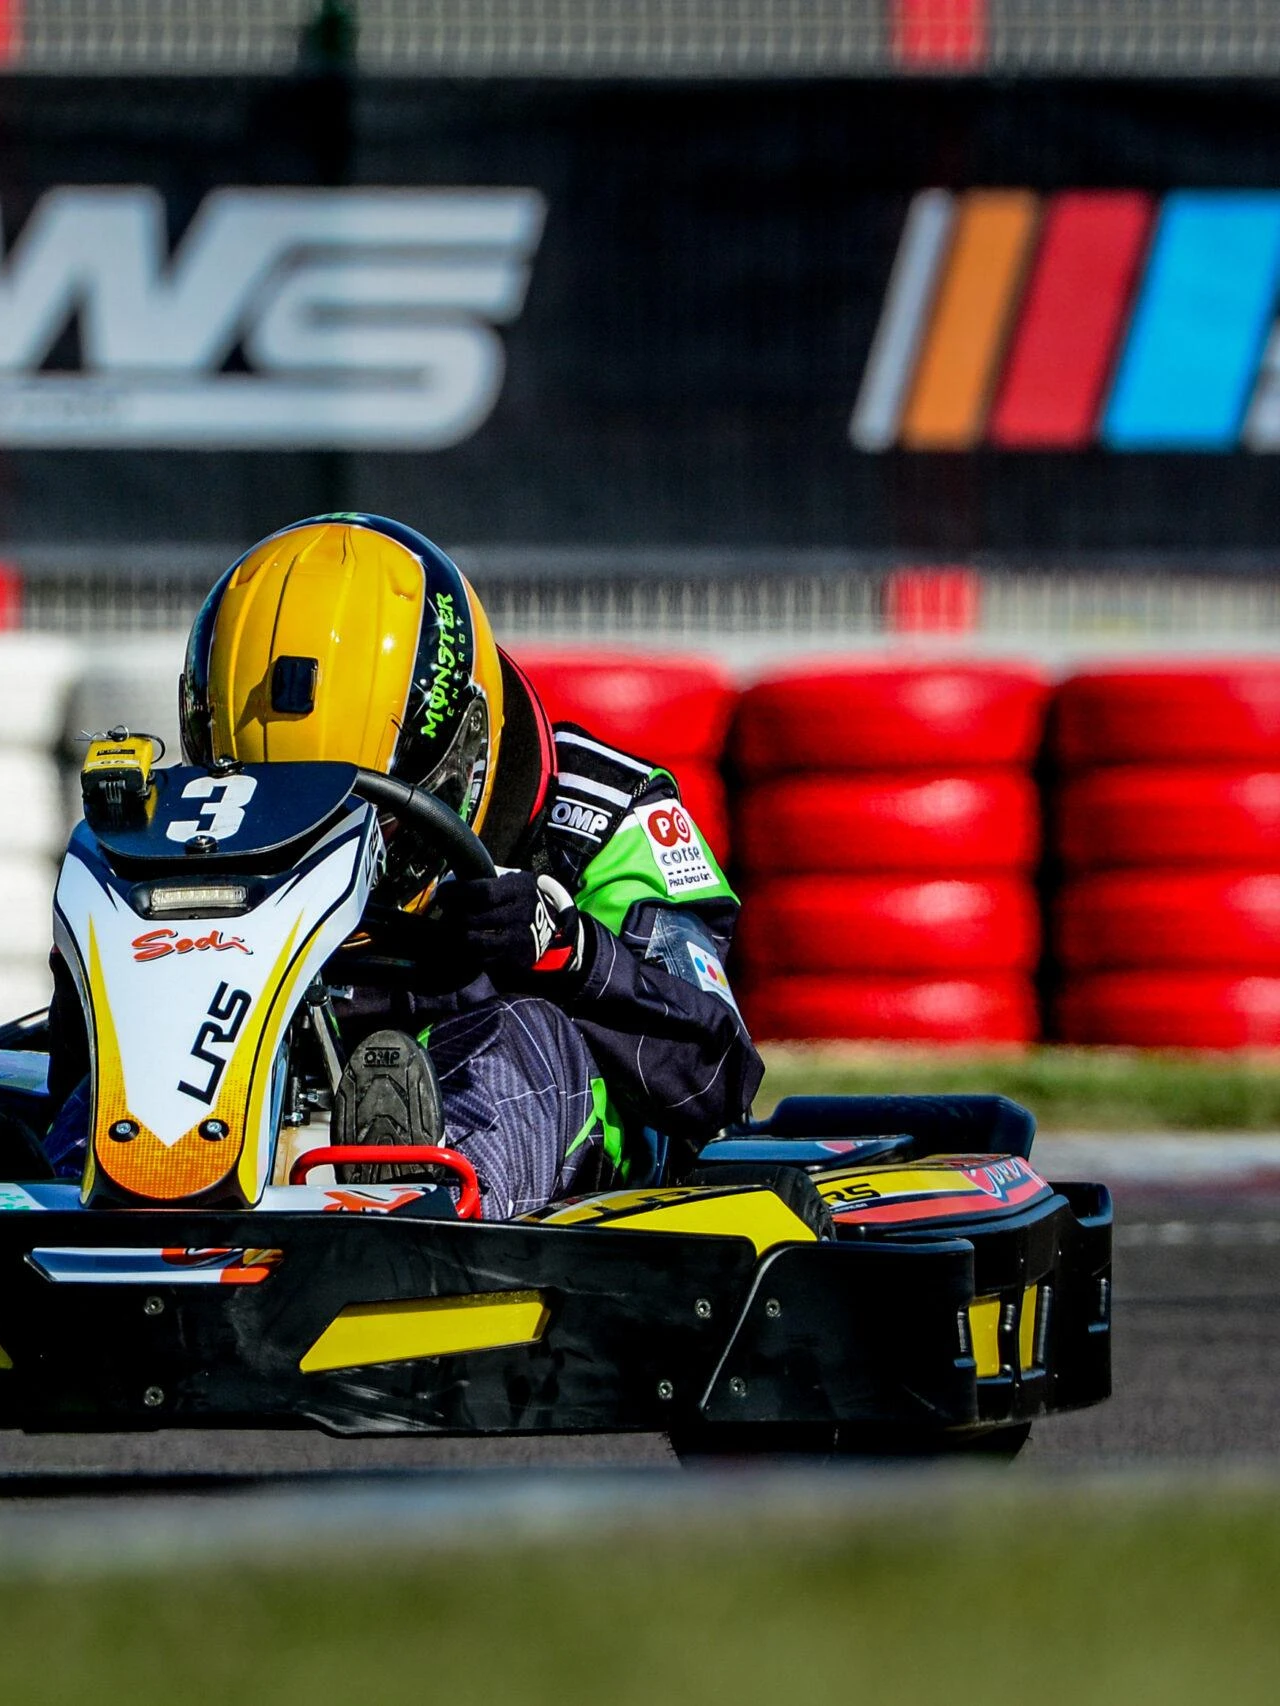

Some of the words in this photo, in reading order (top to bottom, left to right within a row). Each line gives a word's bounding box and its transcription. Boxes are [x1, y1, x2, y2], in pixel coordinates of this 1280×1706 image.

[166, 774, 258, 843] 3
[551, 802, 609, 834] OMP
[660, 846, 702, 867] corse
[131, 928, 253, 962] Sodi
[176, 981, 252, 1106] LRS
[363, 1050, 400, 1065] OMP
